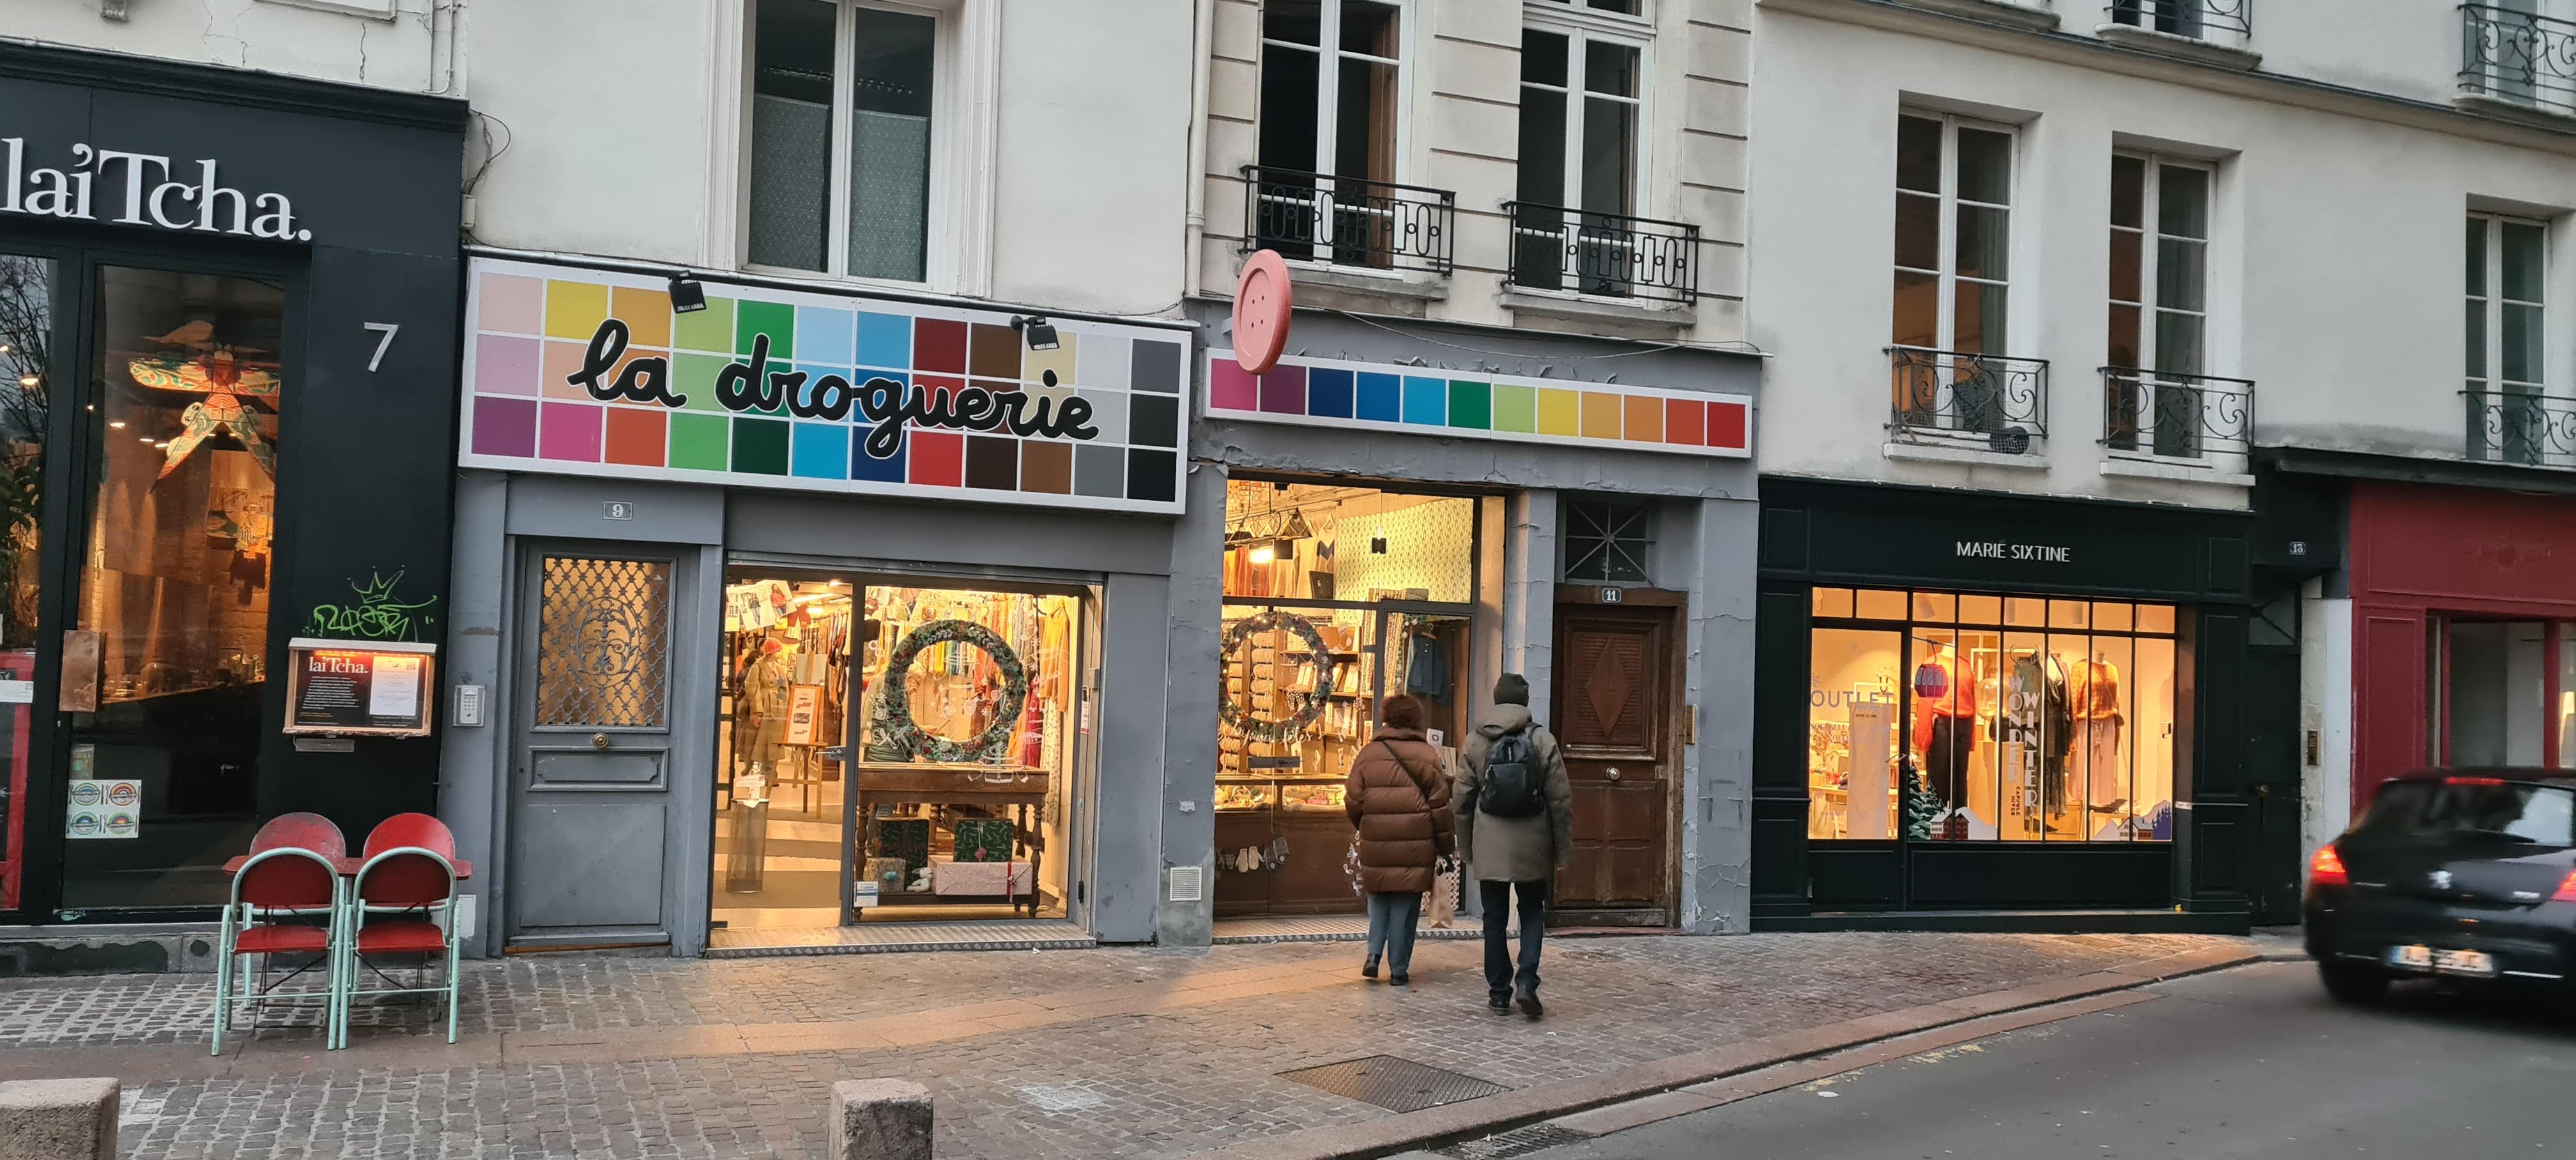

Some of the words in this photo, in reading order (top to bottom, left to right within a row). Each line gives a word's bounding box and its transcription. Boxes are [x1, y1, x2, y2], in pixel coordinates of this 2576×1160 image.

[364, 322, 399, 372] 7
[568, 319, 687, 409] la
[715, 333, 1100, 459] droguerie
[612, 504, 624, 517] 9
[1957, 541, 2006, 558] MARIE
[2011, 544, 2071, 563] SIXTINE
[2293, 544, 2304, 553] 13
[1606, 590, 1616, 601] 11
[1811, 689, 1893, 708] OUTLET
[2023, 692, 2040, 807] WINTER
